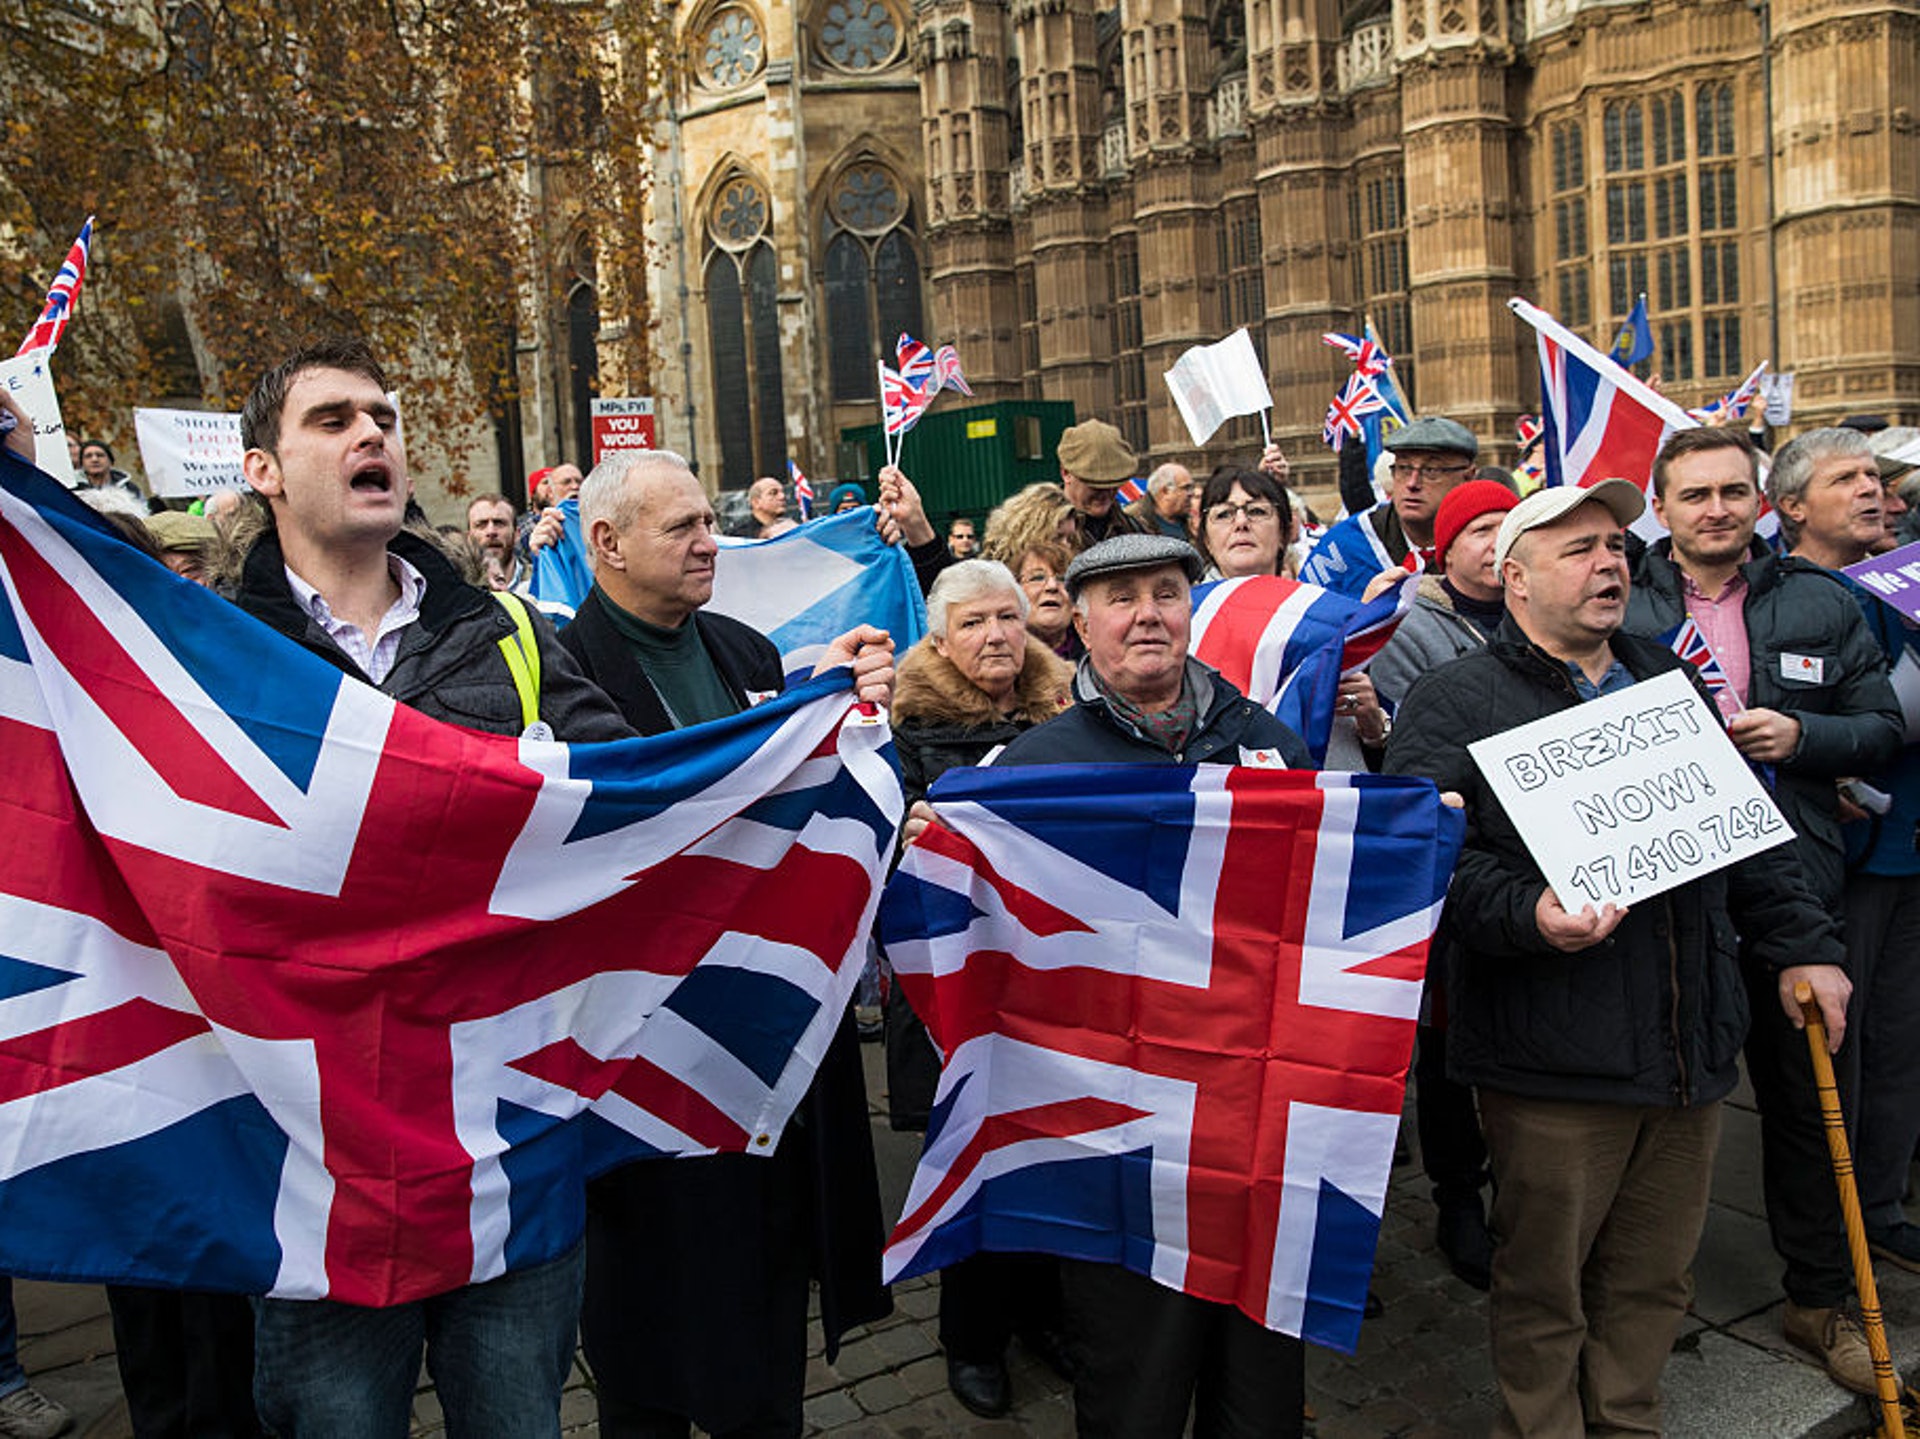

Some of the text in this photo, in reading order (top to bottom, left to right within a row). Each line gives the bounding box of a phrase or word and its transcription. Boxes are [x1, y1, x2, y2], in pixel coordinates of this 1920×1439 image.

[628, 401, 646, 412] FYI
[608, 418, 639, 431] YOU
[601, 432, 647, 446] WORK
[183, 462, 208, 472] We
[184, 475, 228, 488] NOW
[1858, 570, 1910, 595] We
[1504, 699, 1701, 792] BREXIT
[1573, 762, 1717, 835] NOW!
[1571, 798, 1783, 902] 17,410,742
